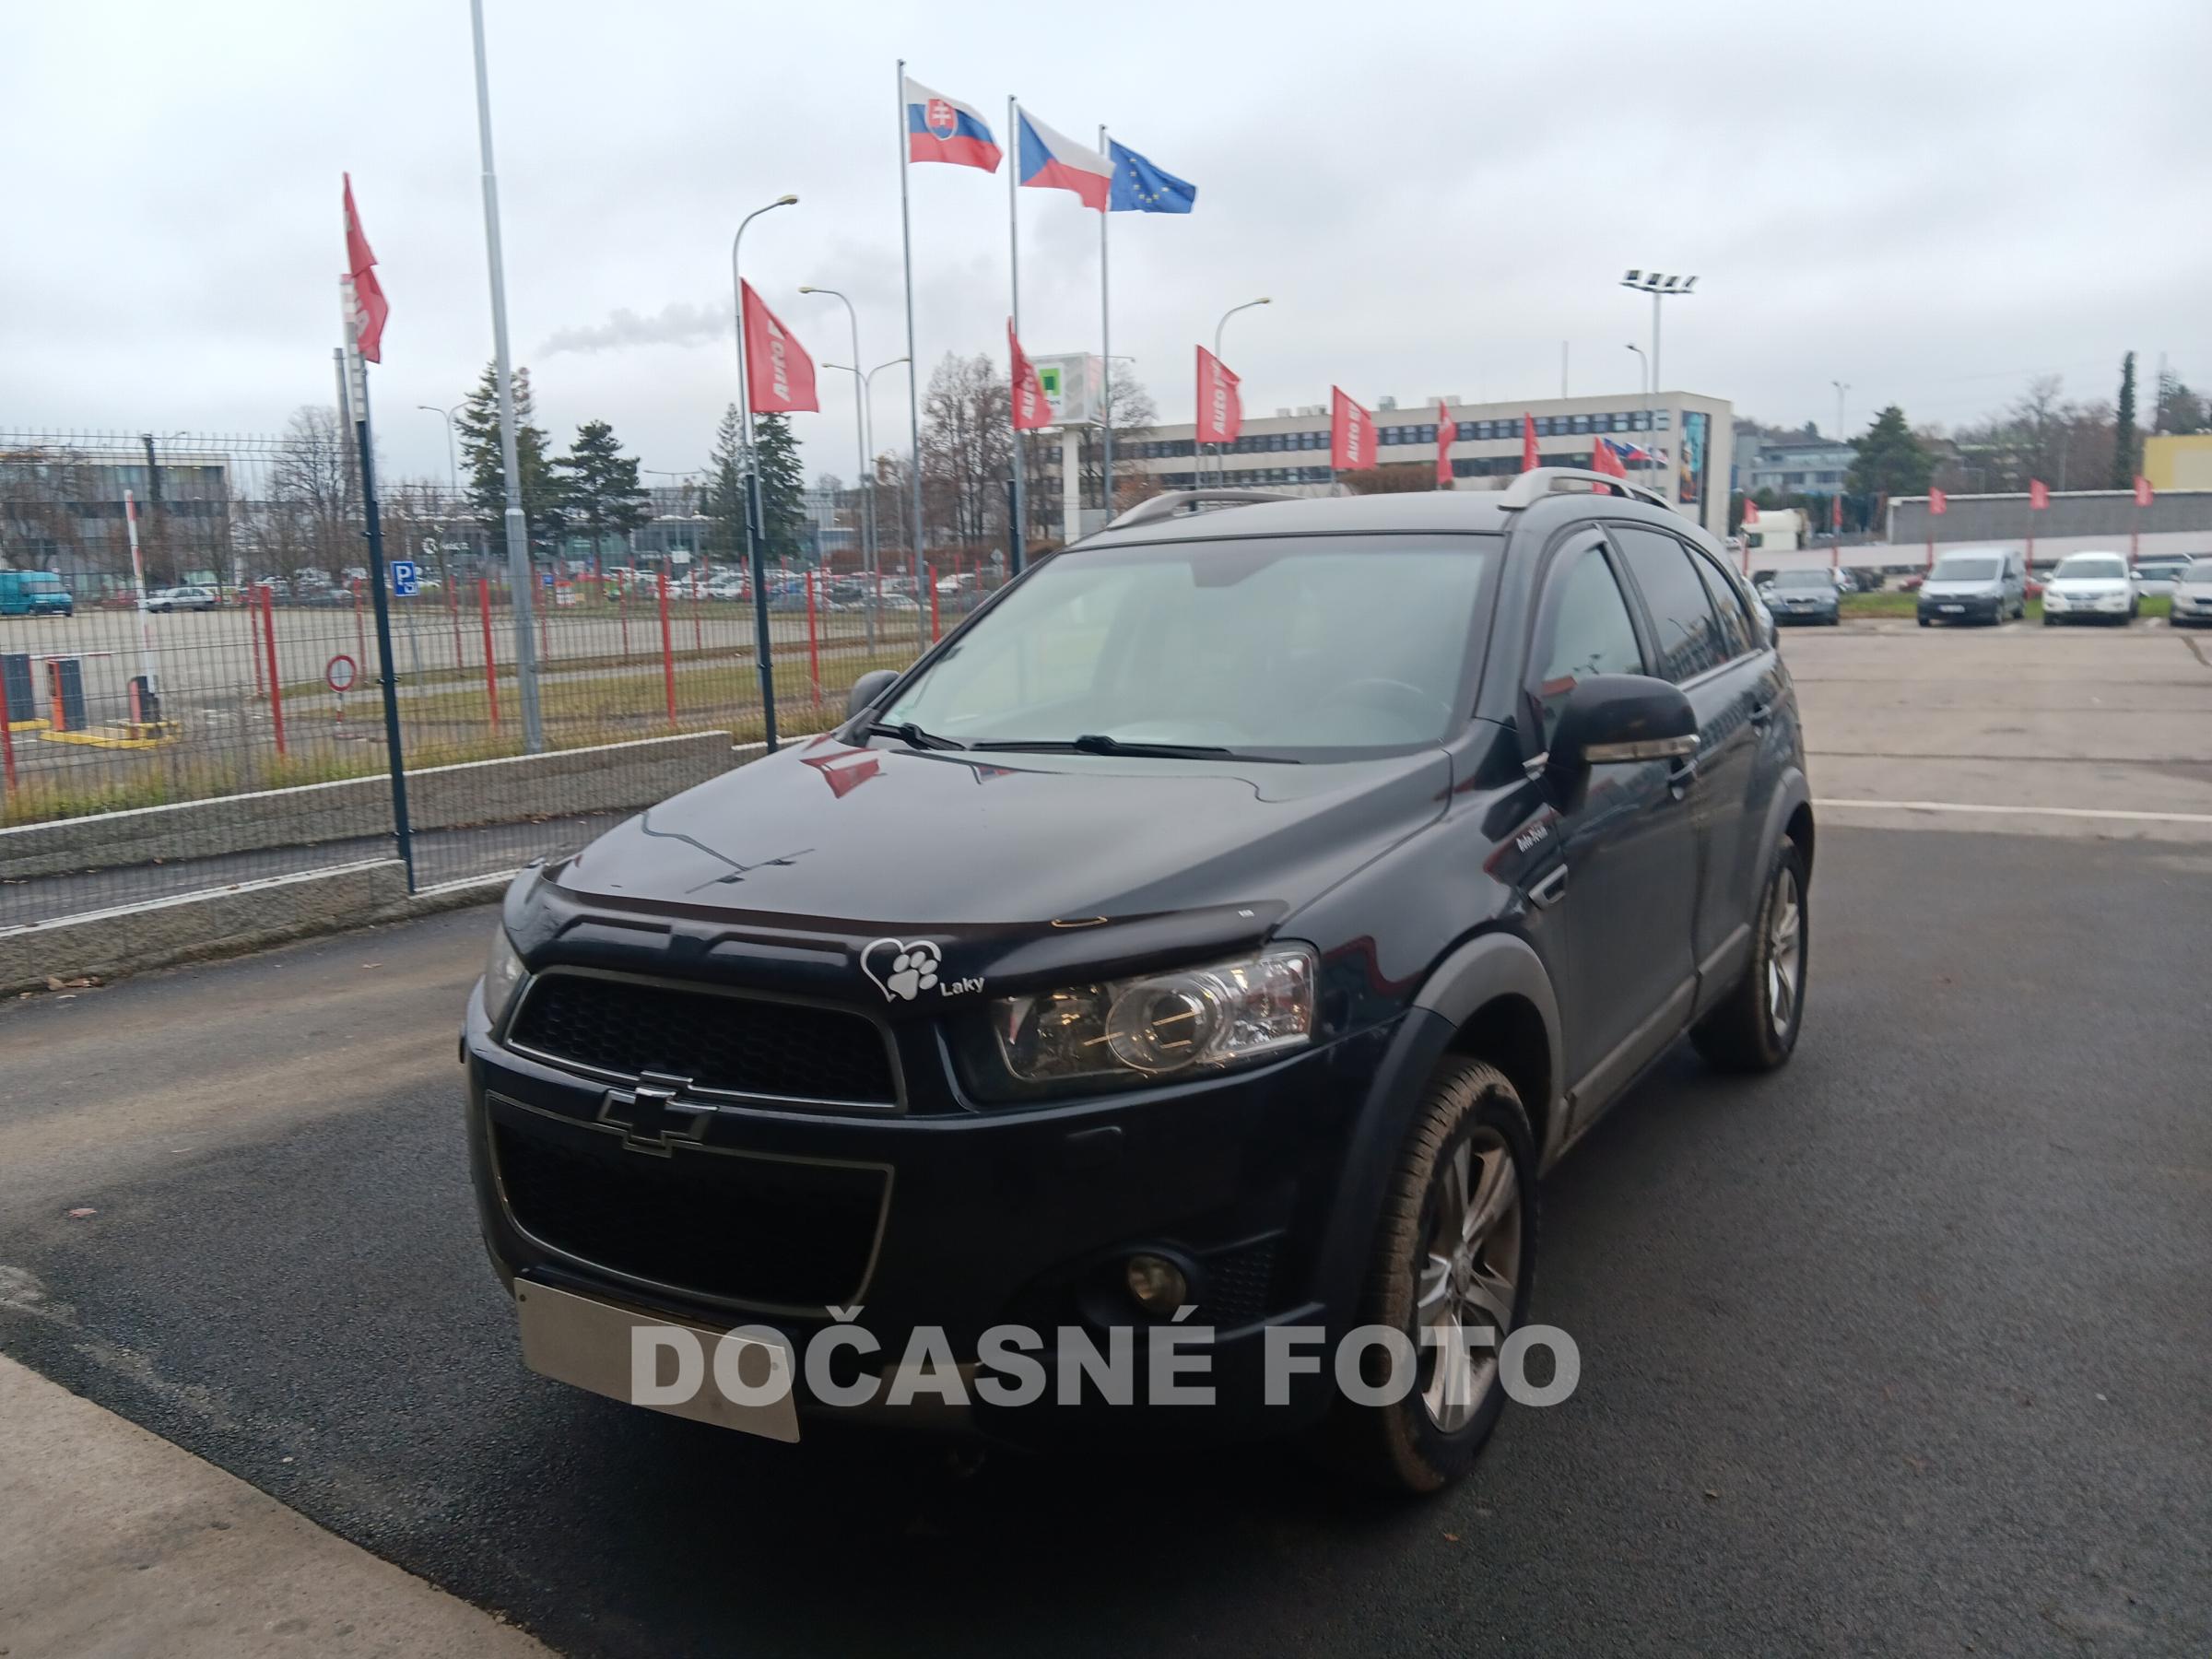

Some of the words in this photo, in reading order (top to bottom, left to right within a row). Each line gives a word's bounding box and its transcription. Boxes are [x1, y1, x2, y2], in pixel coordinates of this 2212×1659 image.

[771, 340, 792, 404] Auto
[1211, 389, 1226, 436] Auto
[1347, 422, 1359, 464] Auto
[395, 565, 412, 585] P
[940, 977, 985, 996] Laky
